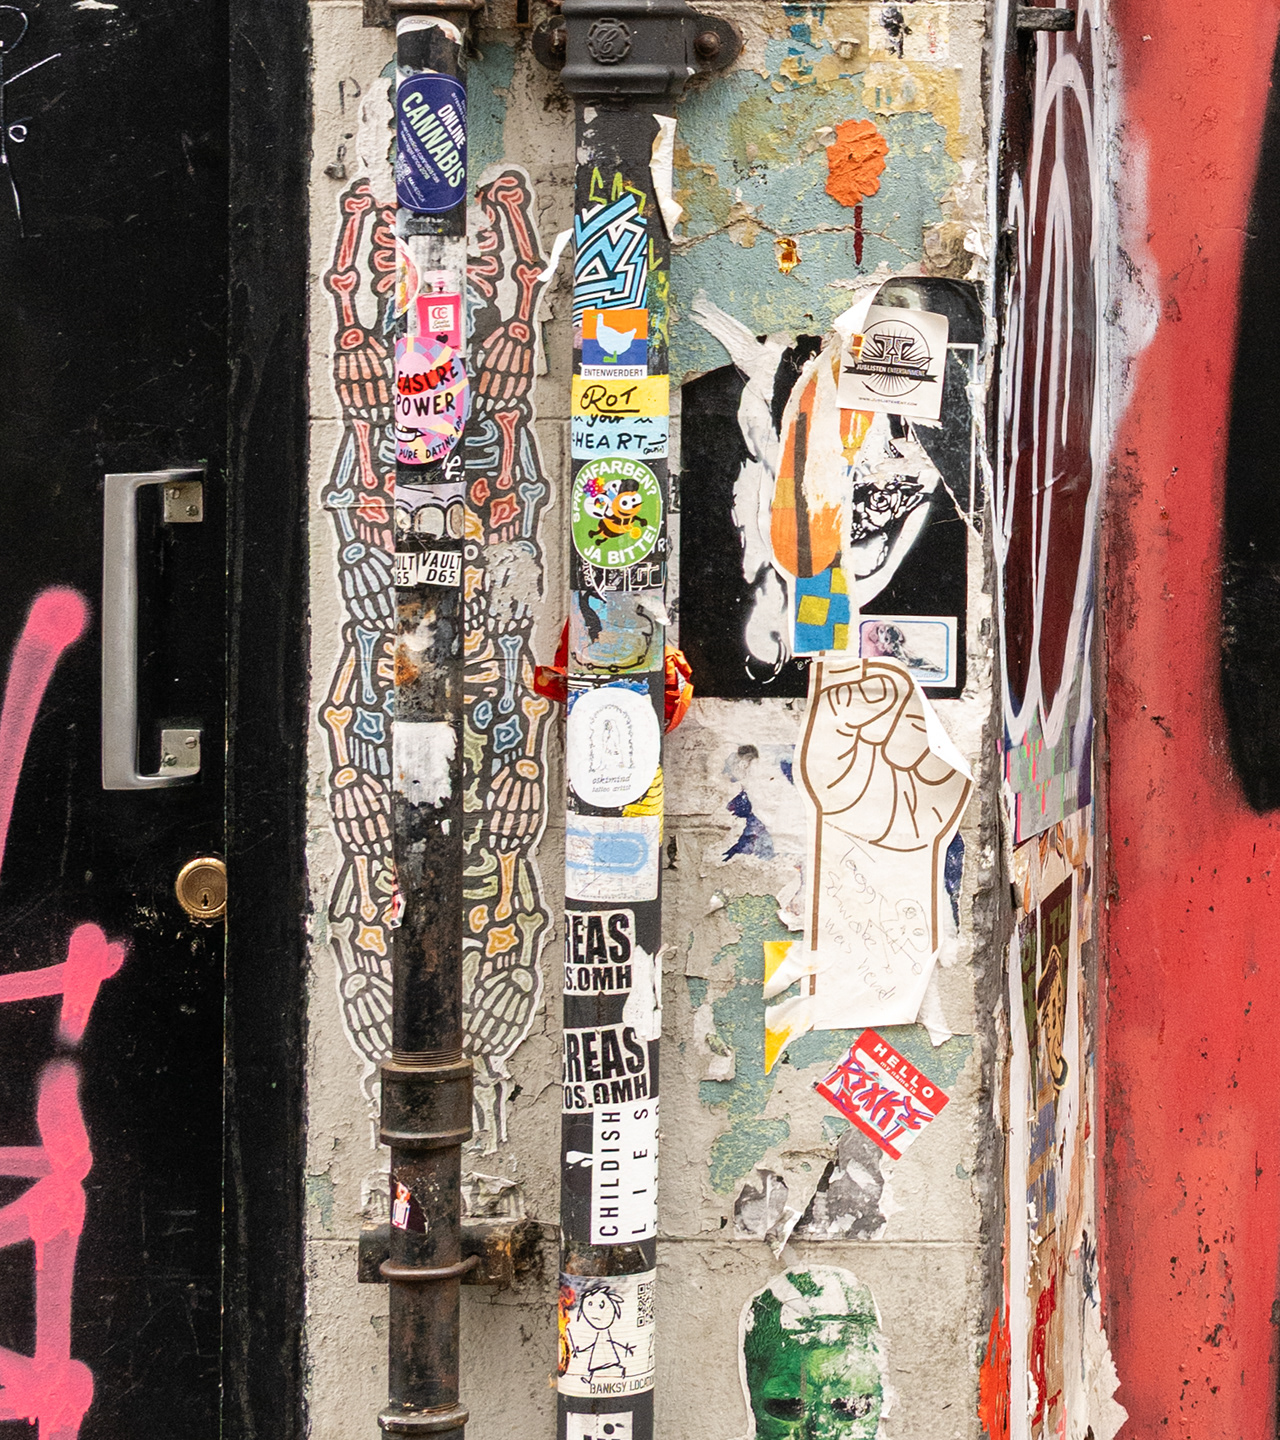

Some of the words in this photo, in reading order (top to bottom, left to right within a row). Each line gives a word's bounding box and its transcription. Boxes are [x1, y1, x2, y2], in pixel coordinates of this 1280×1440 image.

[402, 91, 466, 188] CANNABIS
[438, 103, 466, 149] ONLINE
[584, 368, 643, 377] ENTENWERDER1
[396, 392, 456, 417] POWER
[398, 447, 418, 461] PURE
[425, 433, 456, 459] DATING
[575, 431, 648, 450] HEART
[583, 544, 603, 563] JA
[606, 523, 658, 565] BITTE!
[421, 552, 462, 570] VAULT
[425, 568, 456, 584] D65
[872, 1042, 935, 1099] HELLO
[879, 1060, 891, 1071] my
[890, 1070, 910, 1088] name
[599, 1112, 621, 1237] CHILDISH
[631, 1108, 649, 1235] LIES
[589, 1381, 627, 1395] BANKSY
